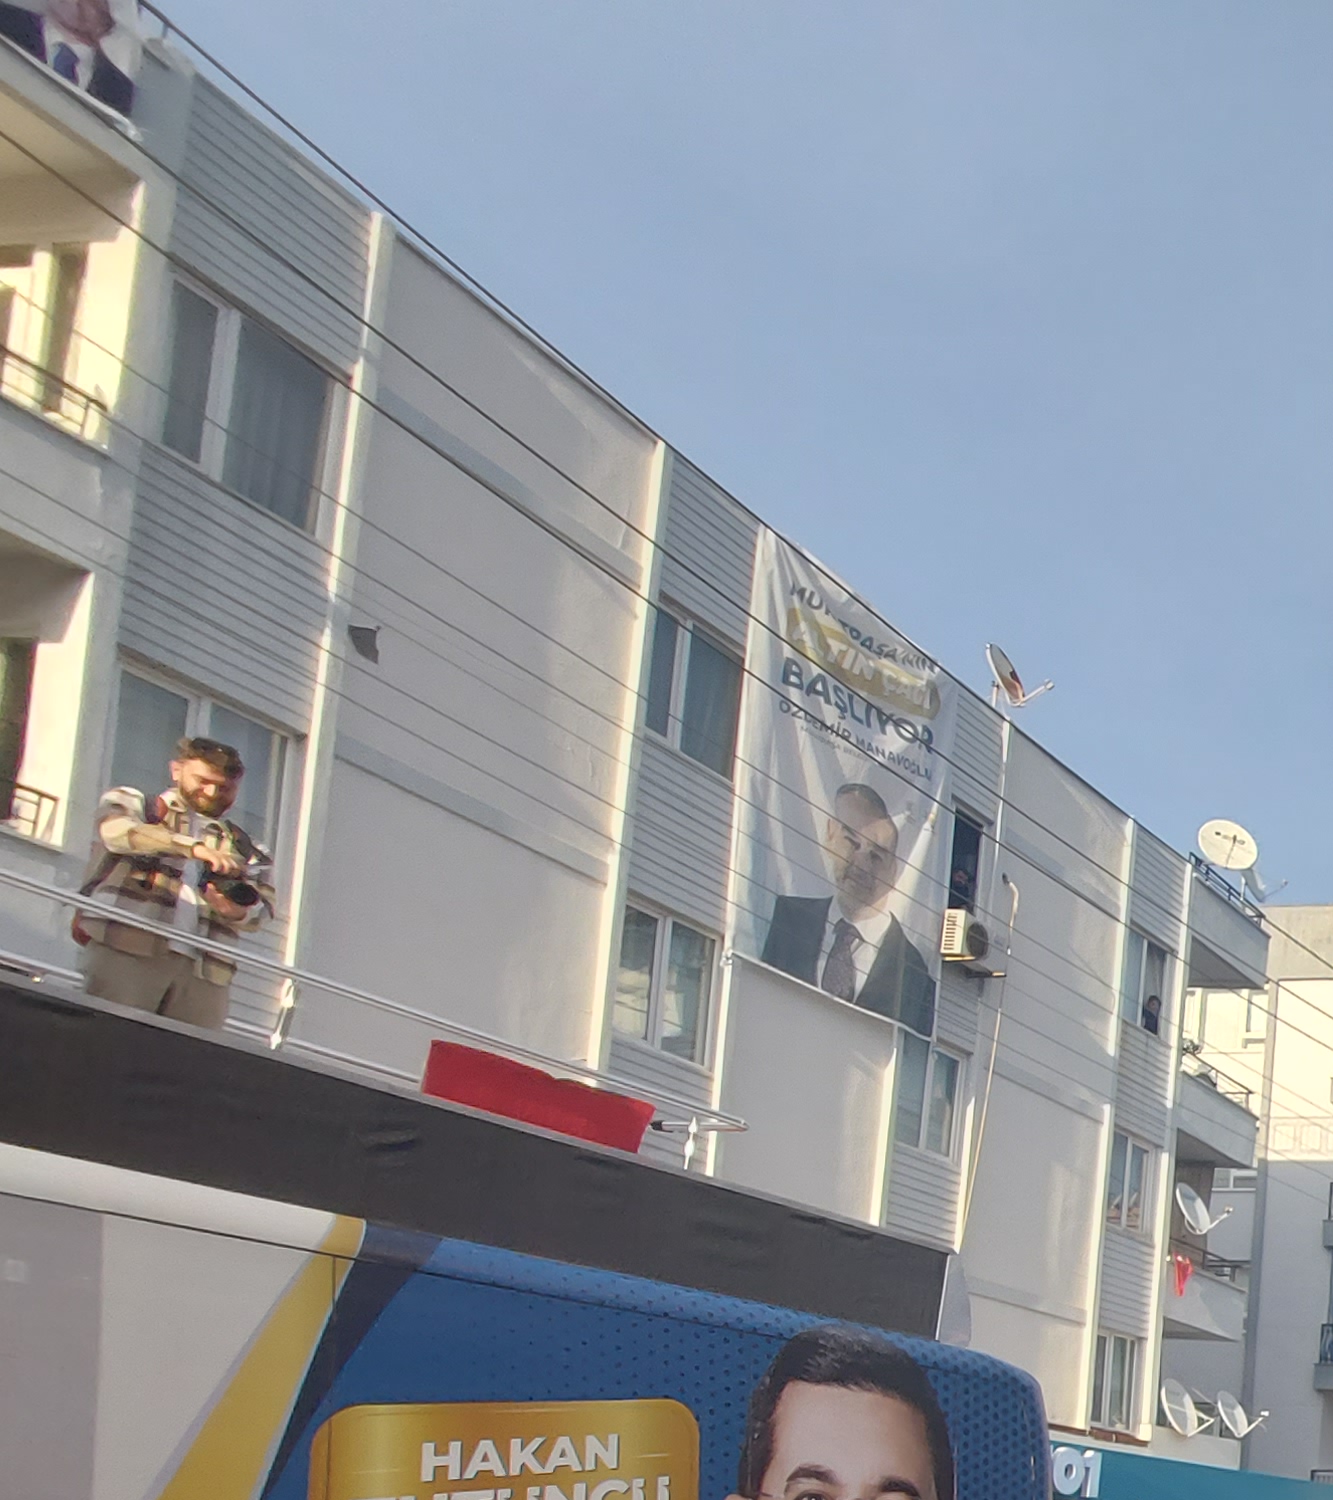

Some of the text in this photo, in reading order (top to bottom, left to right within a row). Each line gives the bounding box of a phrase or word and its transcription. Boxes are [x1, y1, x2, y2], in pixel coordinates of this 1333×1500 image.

[782, 656, 934, 755] BAŞLIYOR
[420, 1433, 620, 1482] HAKAN
[1051, 1445, 1103, 1499] 01
